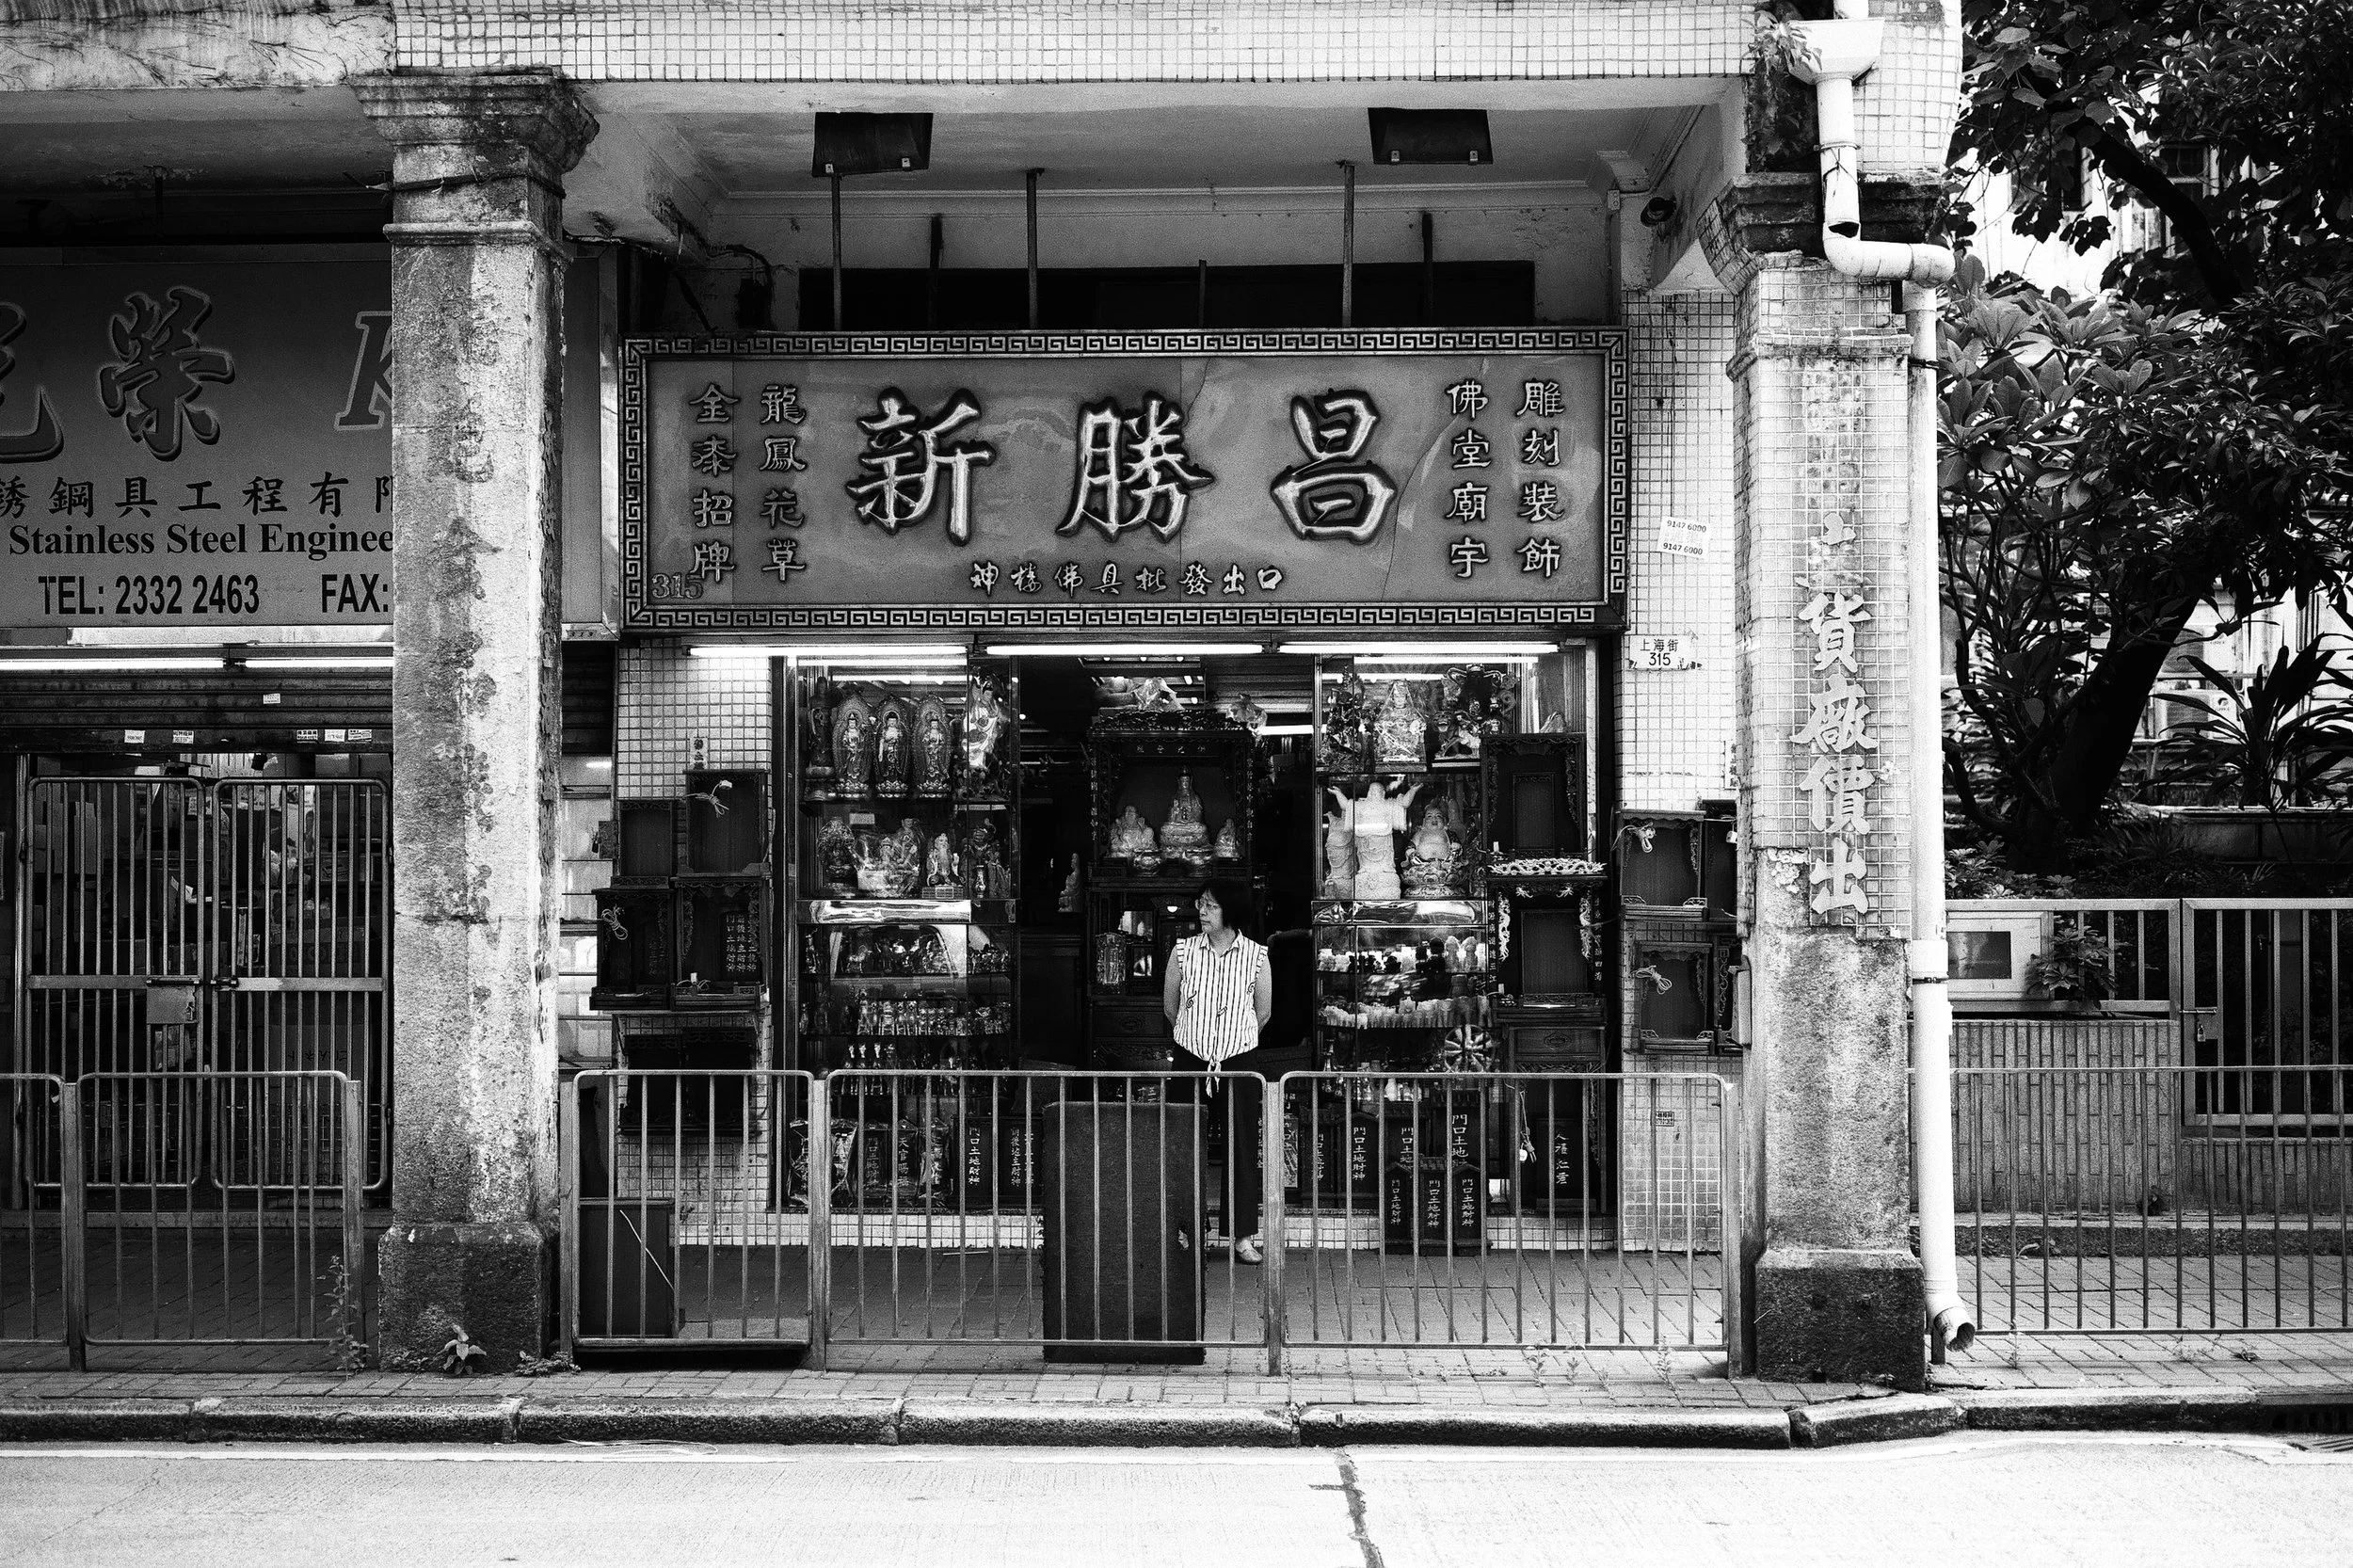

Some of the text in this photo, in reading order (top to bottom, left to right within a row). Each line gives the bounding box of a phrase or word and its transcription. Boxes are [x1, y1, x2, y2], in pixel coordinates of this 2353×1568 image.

[760, 384, 807, 581] 龍鳳花草
[846, 387, 1398, 546] 新勝昌
[1445, 379, 1492, 579] 佛堂廟宇
[1515, 380, 1565, 578] 雕刻裝飾
[8, 522, 392, 561] Stainless Steel Enginee
[1662, 542, 1683, 552] 9147
[1667, 520, 1687, 530] 9147
[38, 573, 389, 615] TEL: 2332 2463 FAX:
[651, 573, 703, 600] 315
[1640, 638, 1679, 652] 上海街
[1648, 652, 1672, 666] 315
[968, 1128, 981, 1186] 門口土地財神
[1353, 1127, 1367, 1180] 門口土地財神
[1427, 1179, 1441, 1227] 門口土地財神
[1462, 1178, 1475, 1226] 門口土地財神
